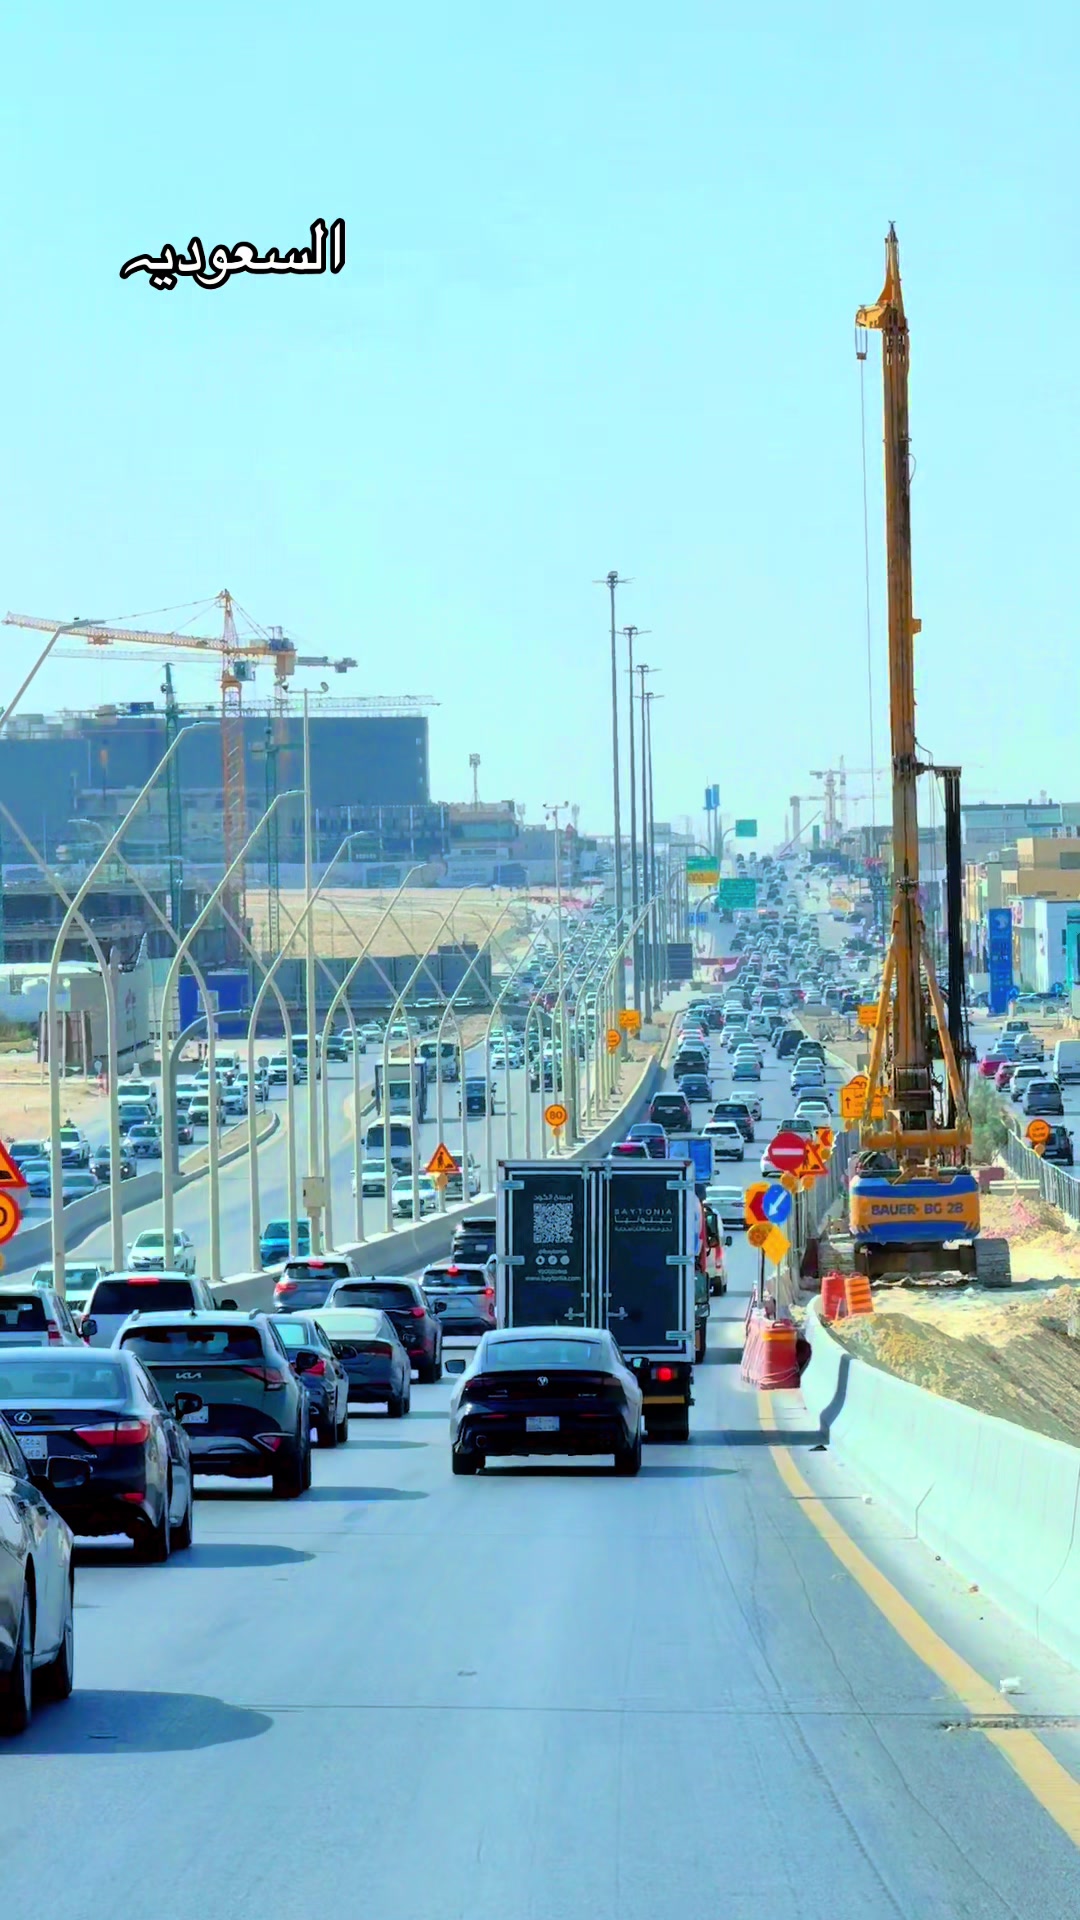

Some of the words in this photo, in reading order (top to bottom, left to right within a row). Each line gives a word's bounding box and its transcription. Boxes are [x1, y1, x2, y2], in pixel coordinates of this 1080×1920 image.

[549, 1110, 563, 1120] 80
[614, 1208, 672, 1216] BAYTONIA
[871, 1203, 917, 1216] BAUER
[947, 1202, 964, 1214] 28
